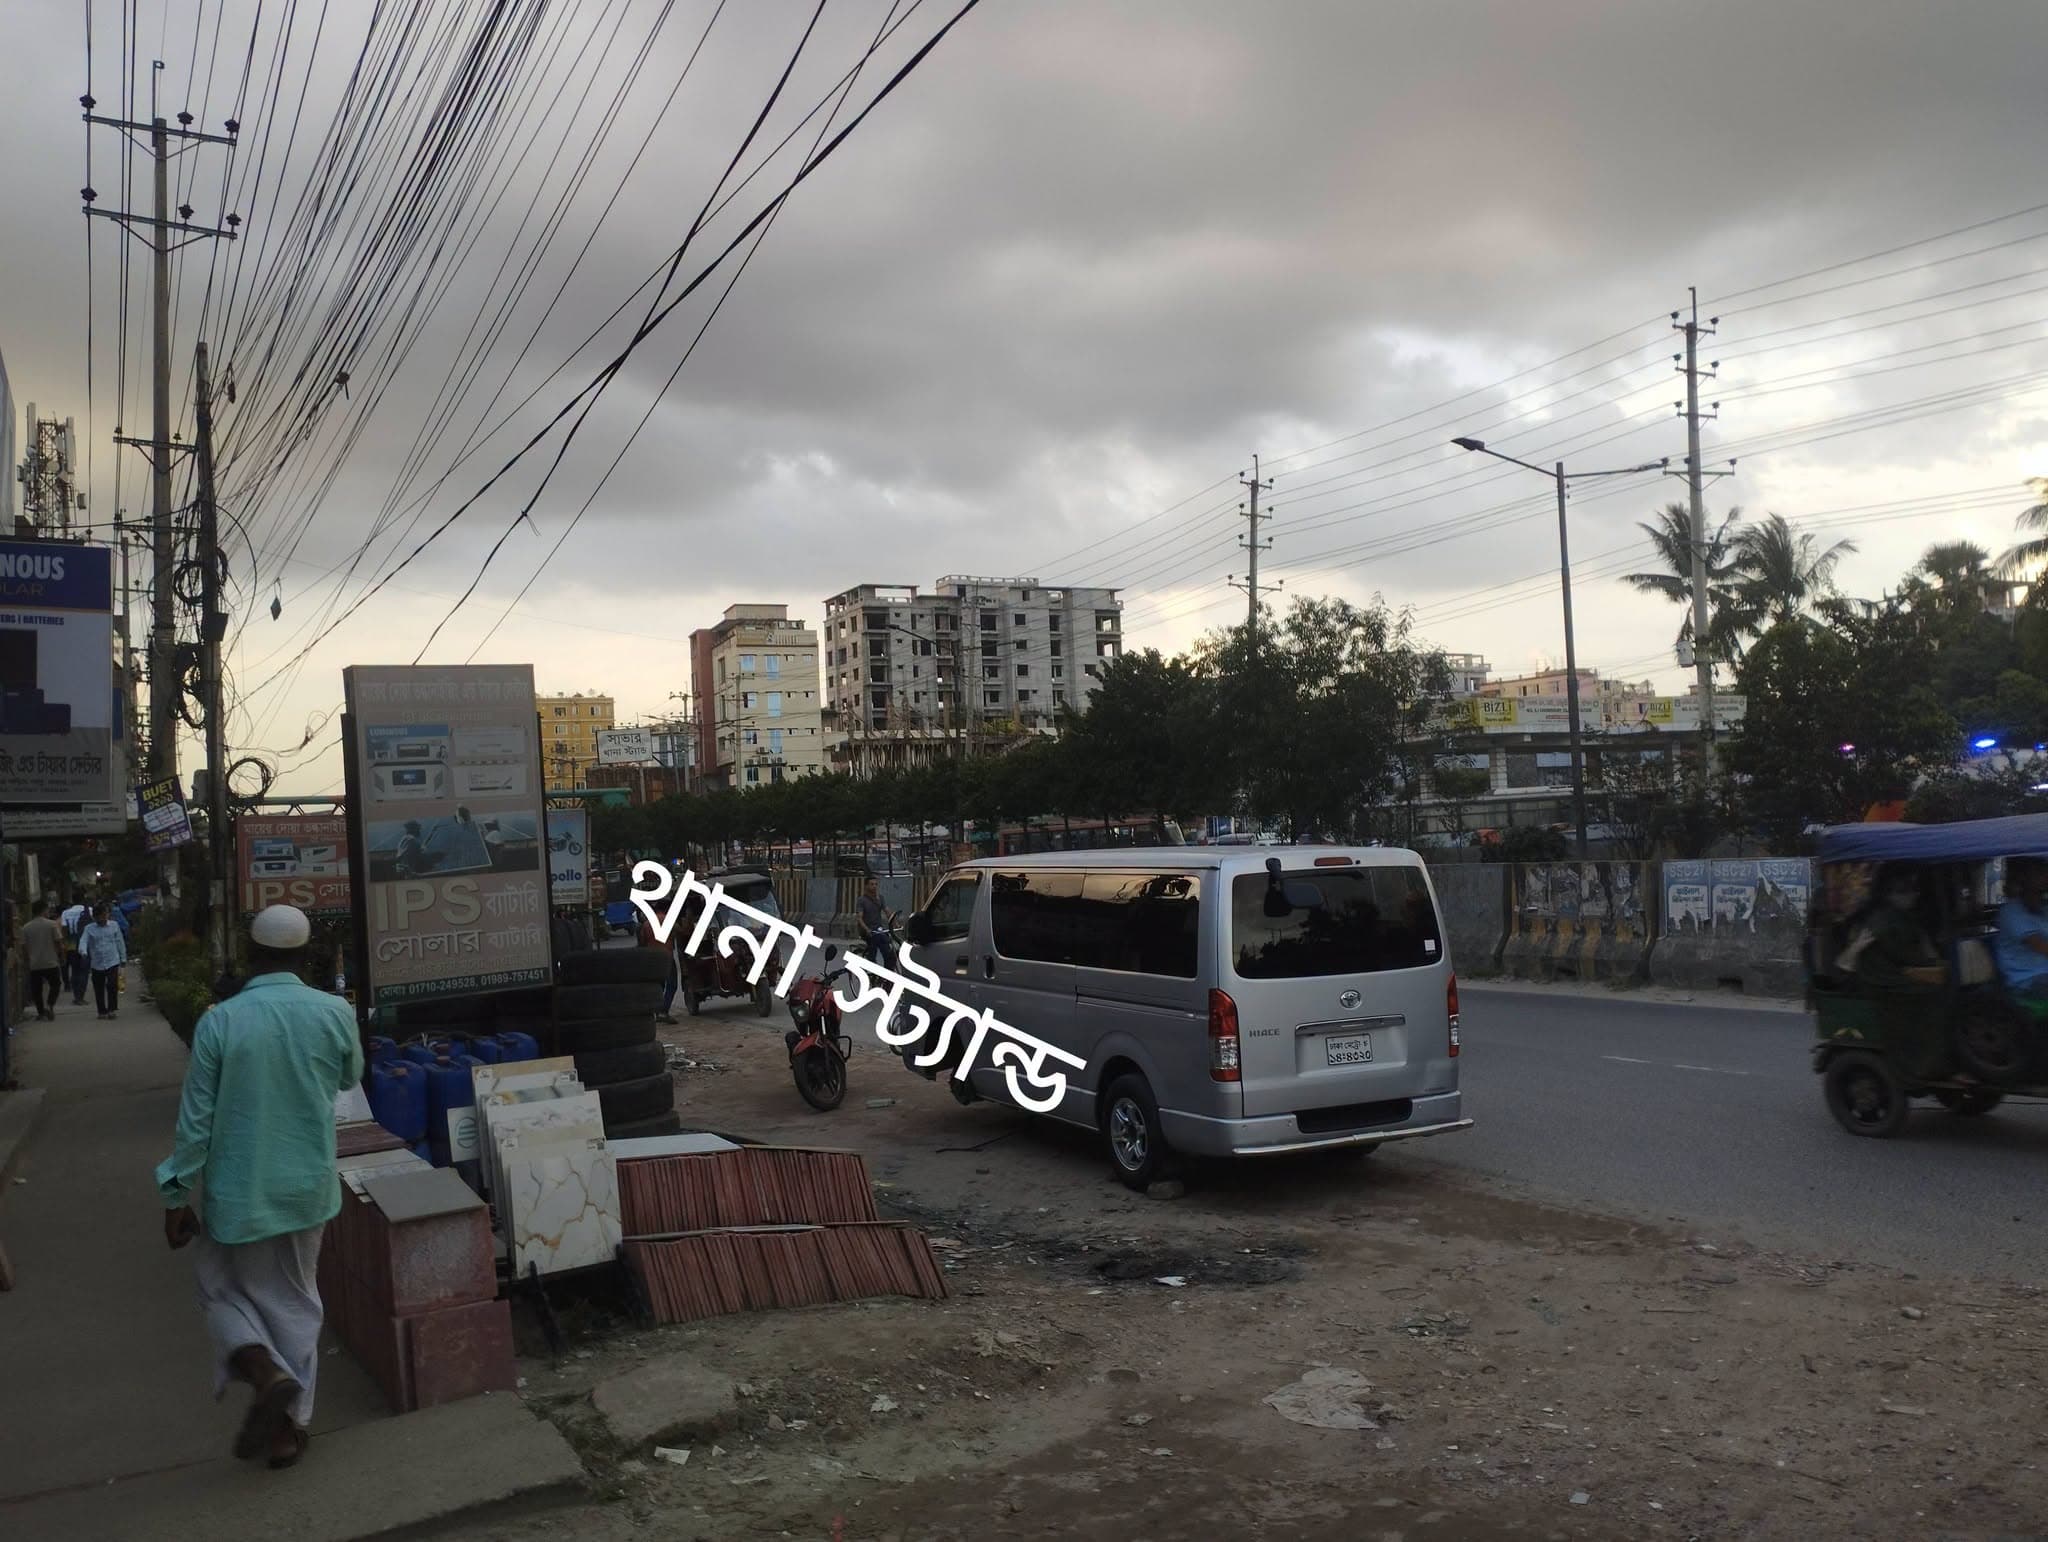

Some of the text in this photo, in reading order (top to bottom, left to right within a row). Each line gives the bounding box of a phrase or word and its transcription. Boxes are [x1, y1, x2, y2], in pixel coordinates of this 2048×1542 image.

[0, 583, 43, 596] LAR
[142, 778, 174, 802] BUET
[245, 880, 316, 911] IPS
[375, 877, 482, 933] IPS
[375, 929, 486, 963] সোলার
[1248, 1028, 1281, 1039] HIACE
